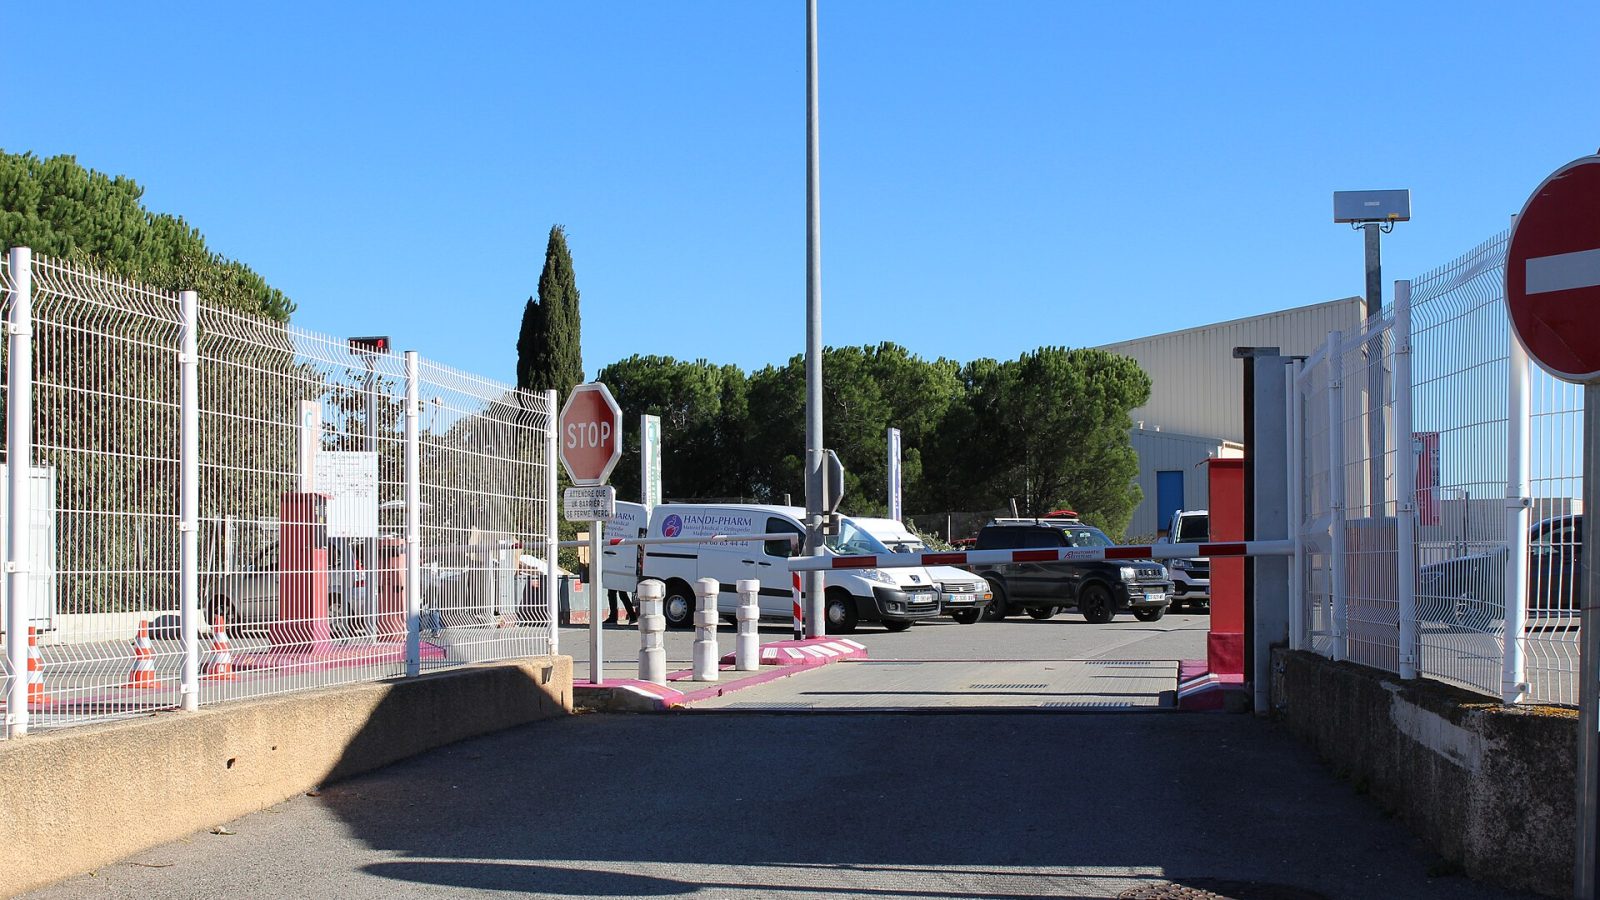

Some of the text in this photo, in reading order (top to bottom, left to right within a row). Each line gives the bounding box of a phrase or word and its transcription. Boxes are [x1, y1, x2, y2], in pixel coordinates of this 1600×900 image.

[567, 421, 611, 449] STOP
[596, 489, 606, 498] QUE
[683, 515, 752, 526] HANDI-PHARM
